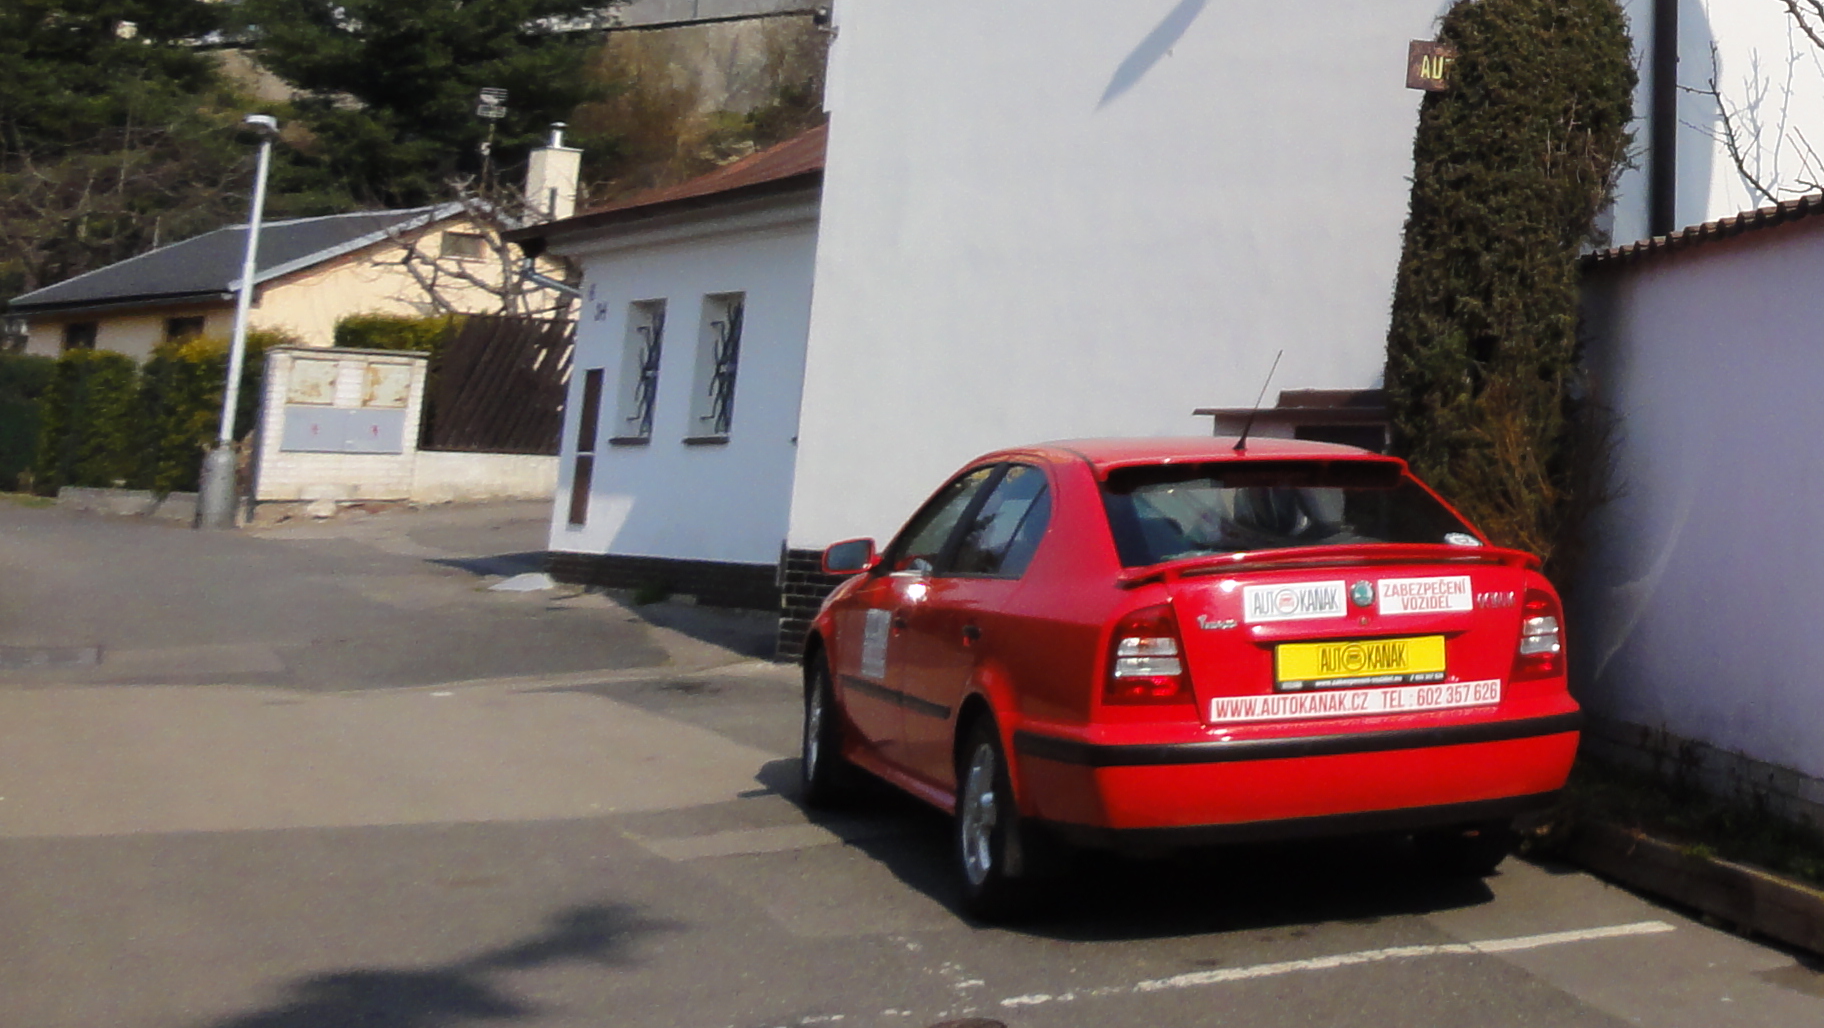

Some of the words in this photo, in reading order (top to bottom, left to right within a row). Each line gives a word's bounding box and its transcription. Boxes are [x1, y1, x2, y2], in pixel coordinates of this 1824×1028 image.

[1401, 595, 1453, 611] VOZIDEL
[1416, 687, 1443, 707] 602
[1446, 684, 1471, 704] 357
[1473, 681, 1498, 701] 626
